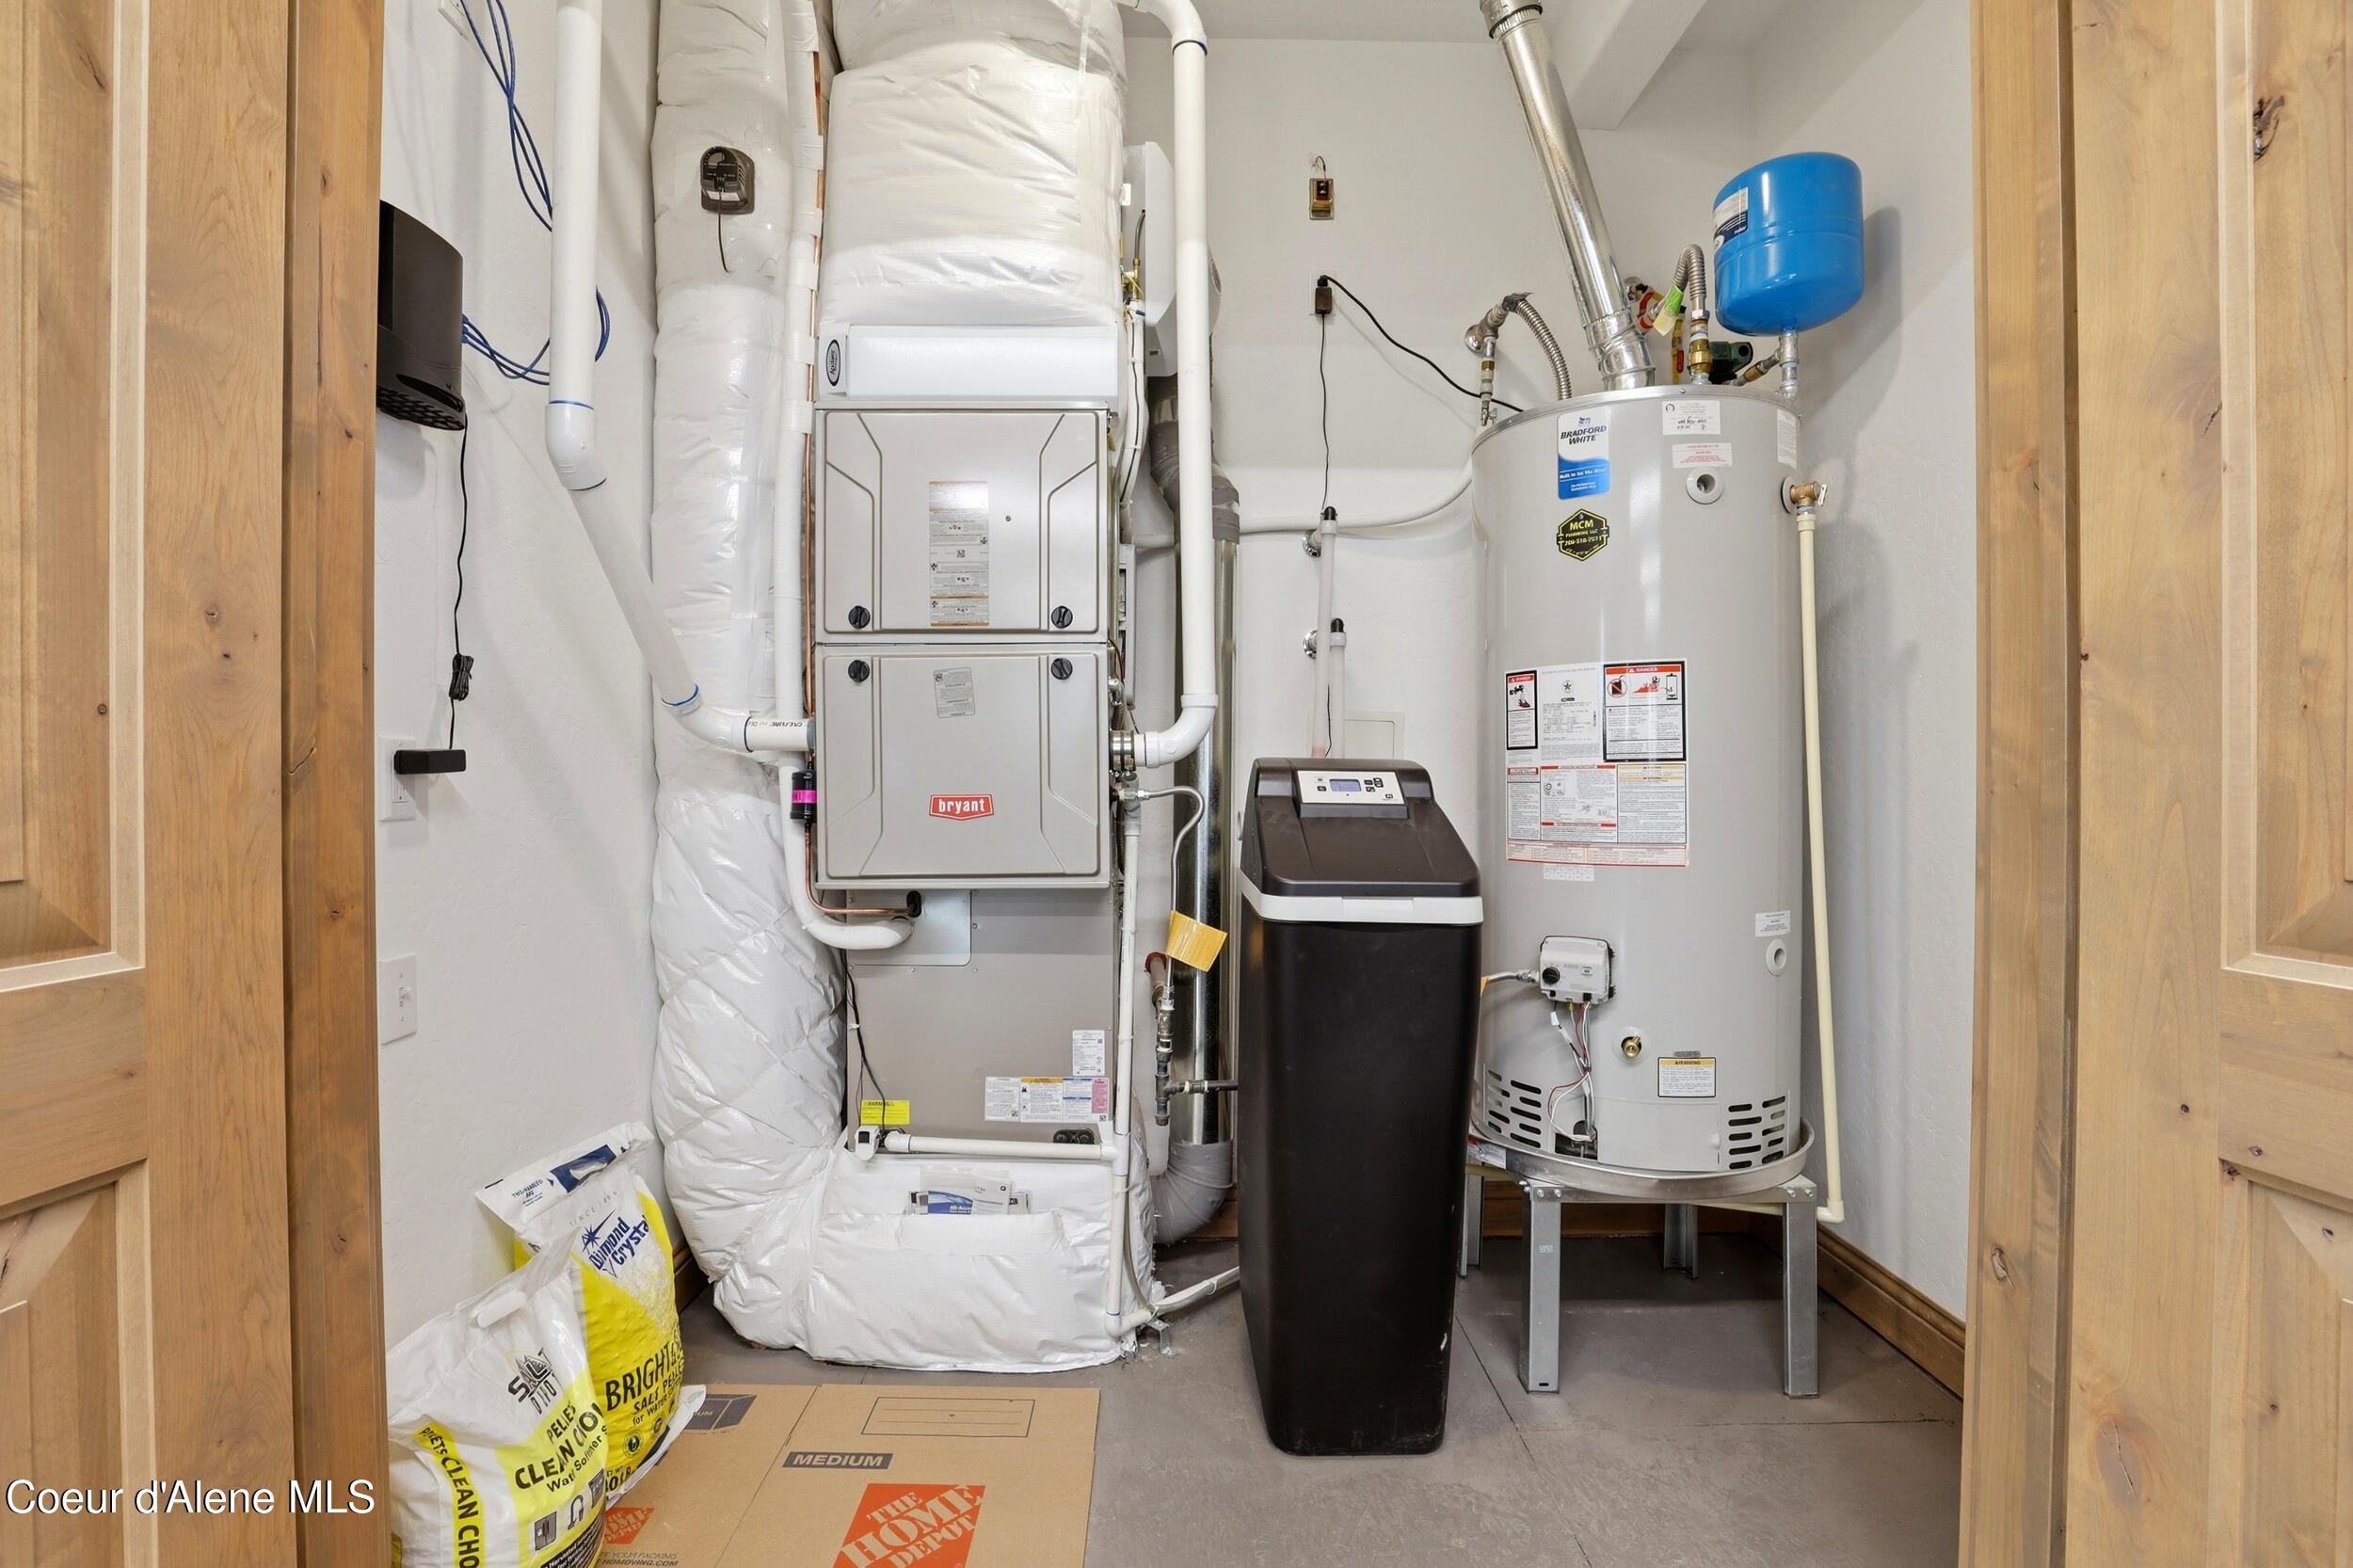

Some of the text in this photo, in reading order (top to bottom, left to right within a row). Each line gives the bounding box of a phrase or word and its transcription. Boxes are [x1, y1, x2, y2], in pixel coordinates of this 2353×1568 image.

[1561, 424, 1608, 440] BRADFORD
[1568, 434, 1597, 445] WHITE
[1569, 520, 1593, 531] MCM
[938, 798, 985, 814] bryant
[605, 1341, 670, 1412] BRIGHT
[632, 1414, 645, 1427] for
[515, 1439, 576, 1489] CLEAN
[792, 1454, 883, 1467] MEDIUM
[440, 1456, 479, 1520] CLEAN
[866, 1491, 923, 1525] THE
[841, 1485, 983, 1568] HOME
[888, 1514, 976, 1568] DEPOT
[457, 1525, 480, 1568] CHO
